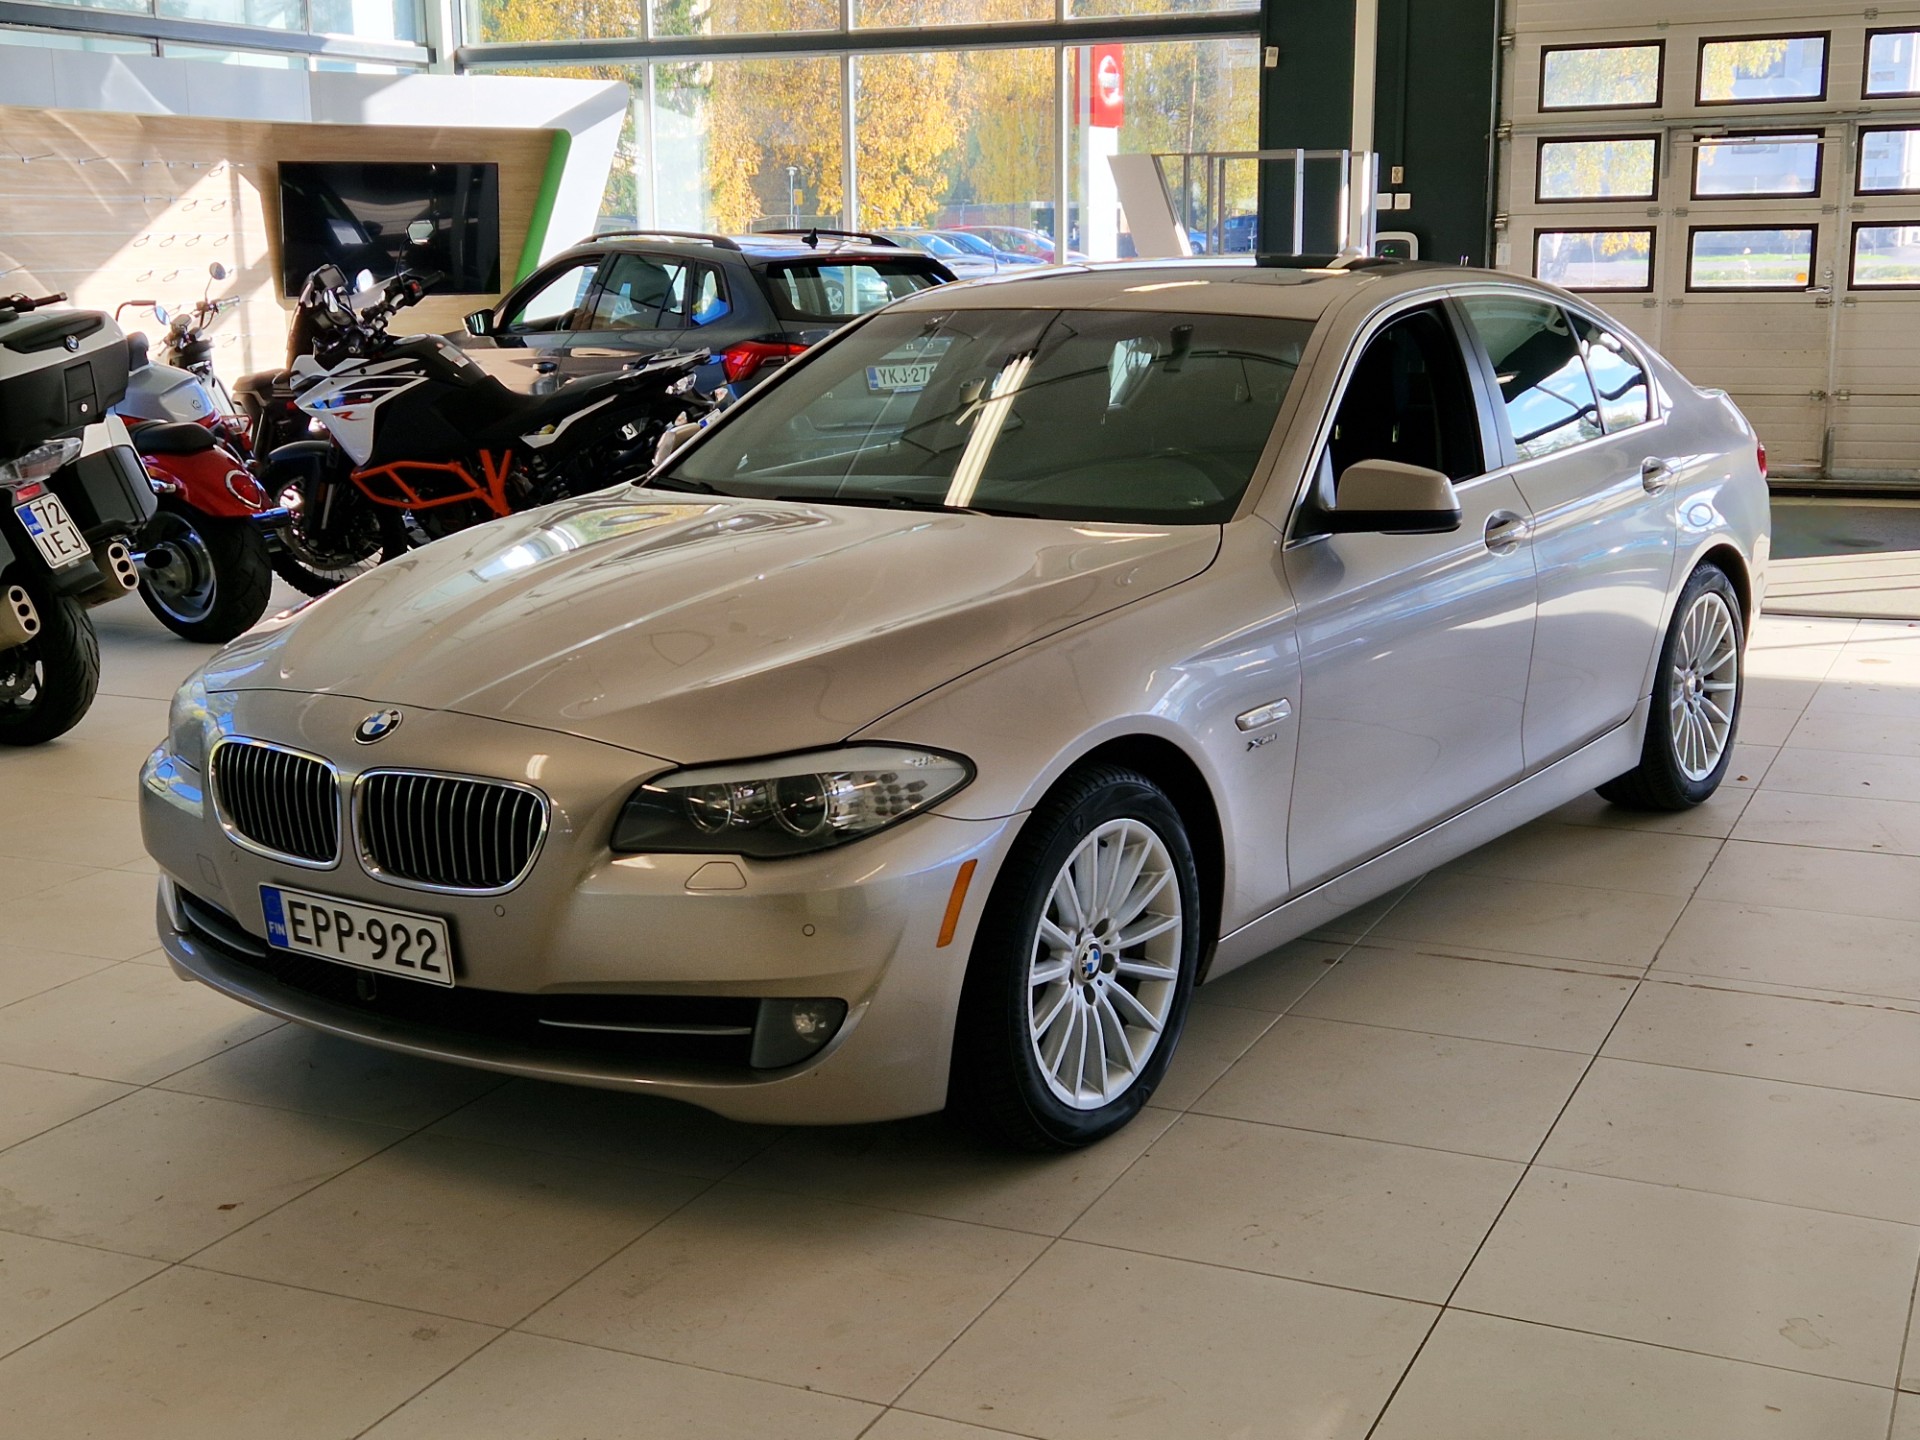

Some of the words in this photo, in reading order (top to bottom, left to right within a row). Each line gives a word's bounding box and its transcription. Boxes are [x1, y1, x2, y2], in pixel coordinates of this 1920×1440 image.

[34, 502, 67, 528] 72
[42, 526, 81, 558] IEJ
[268, 921, 286, 936] FIN
[288, 899, 441, 973] EPP-922
